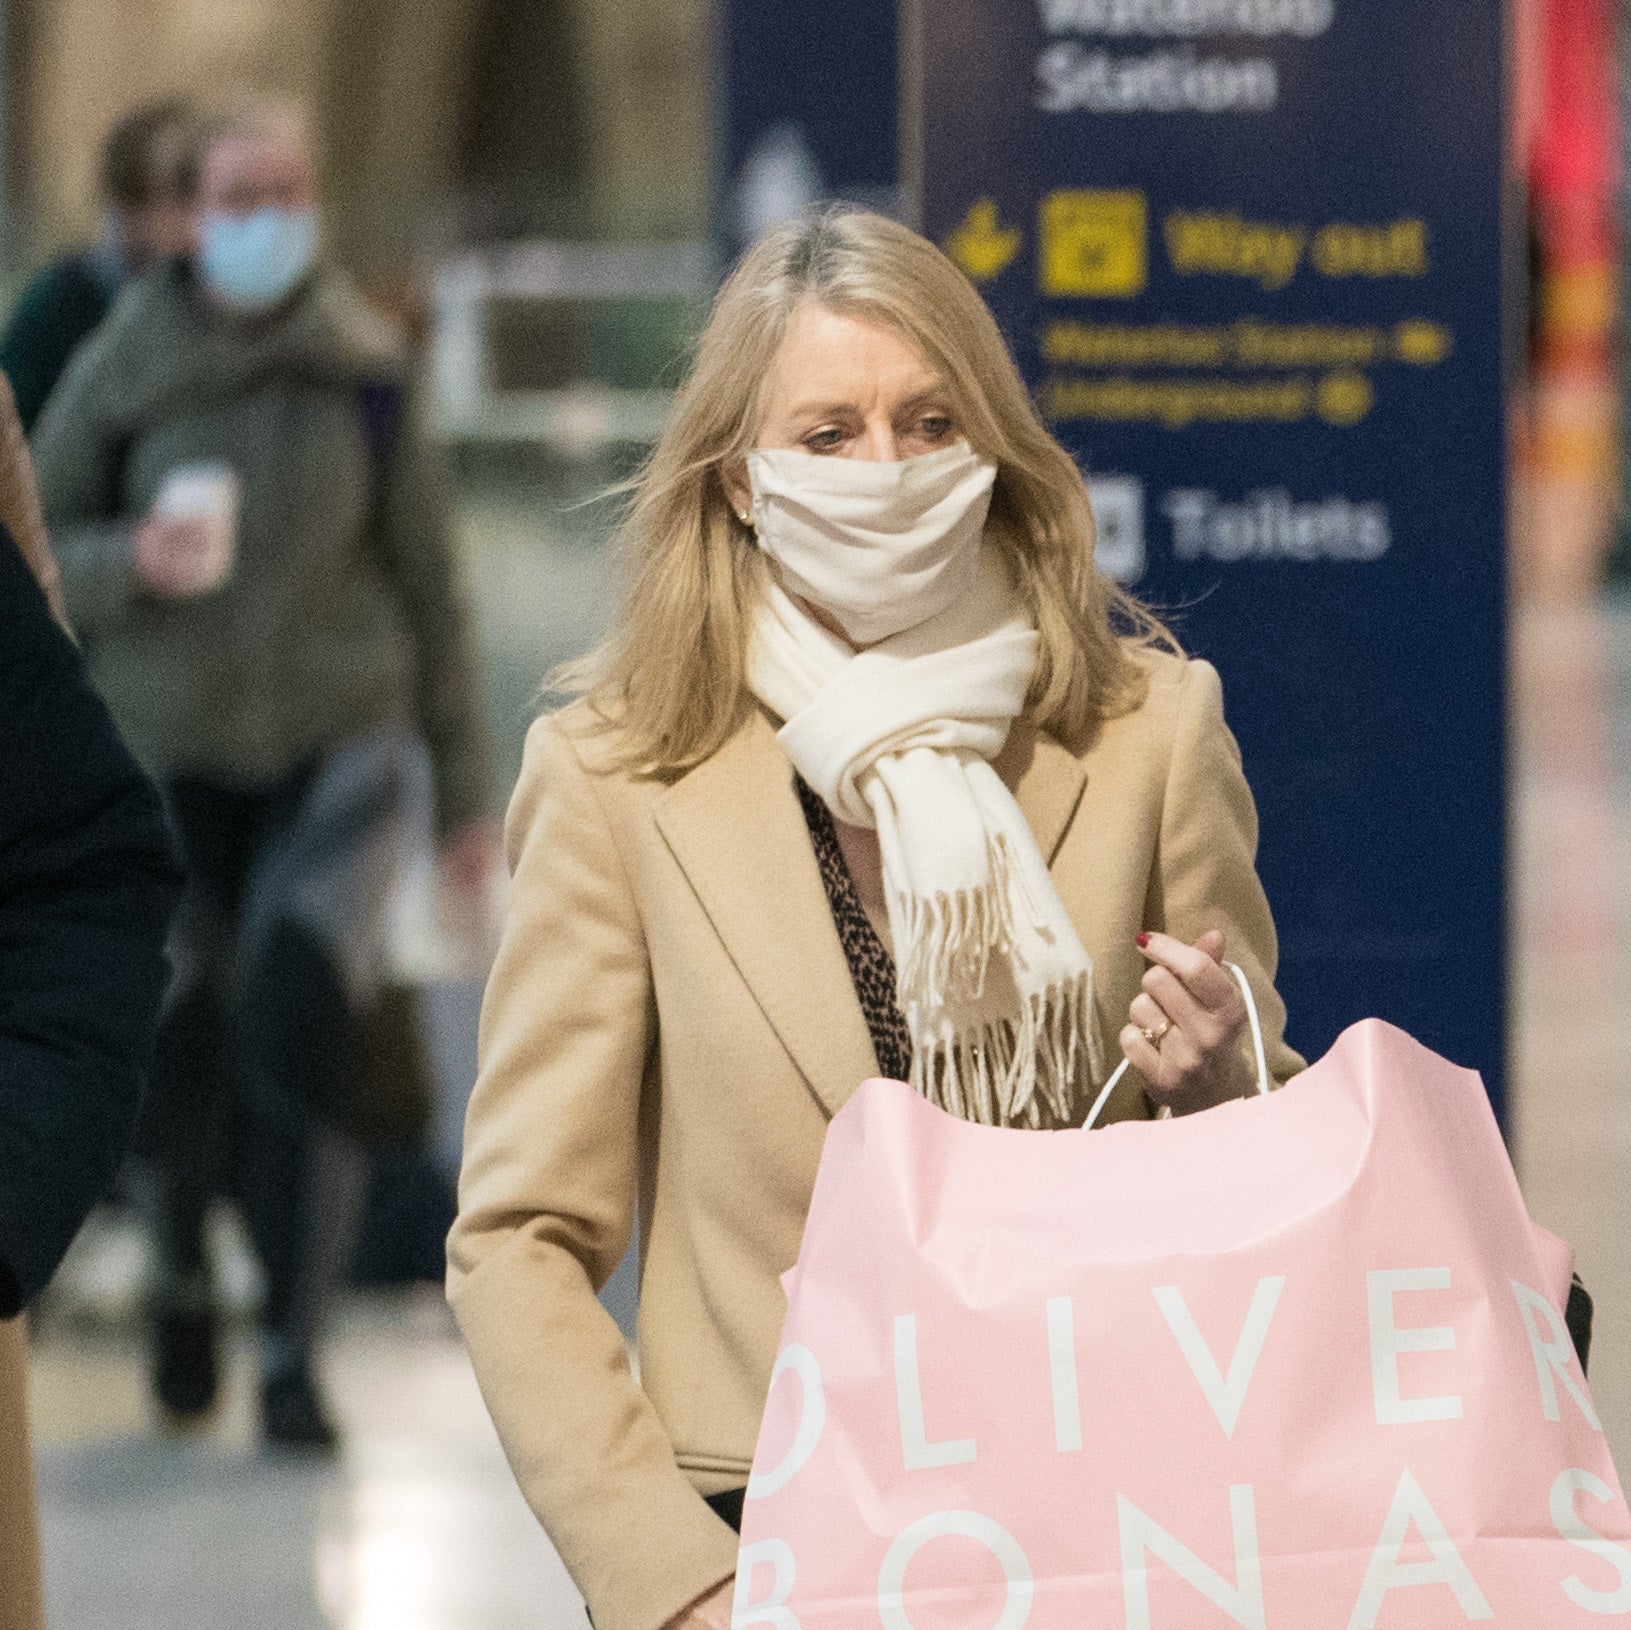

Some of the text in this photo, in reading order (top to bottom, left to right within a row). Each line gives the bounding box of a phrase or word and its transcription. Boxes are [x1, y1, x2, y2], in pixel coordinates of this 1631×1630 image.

[1039, 45, 1276, 110] Station
[1165, 210, 1427, 288] Way out
[1167, 491, 1389, 559] Toilets
[744, 1267, 1601, 1499] OLIVER
